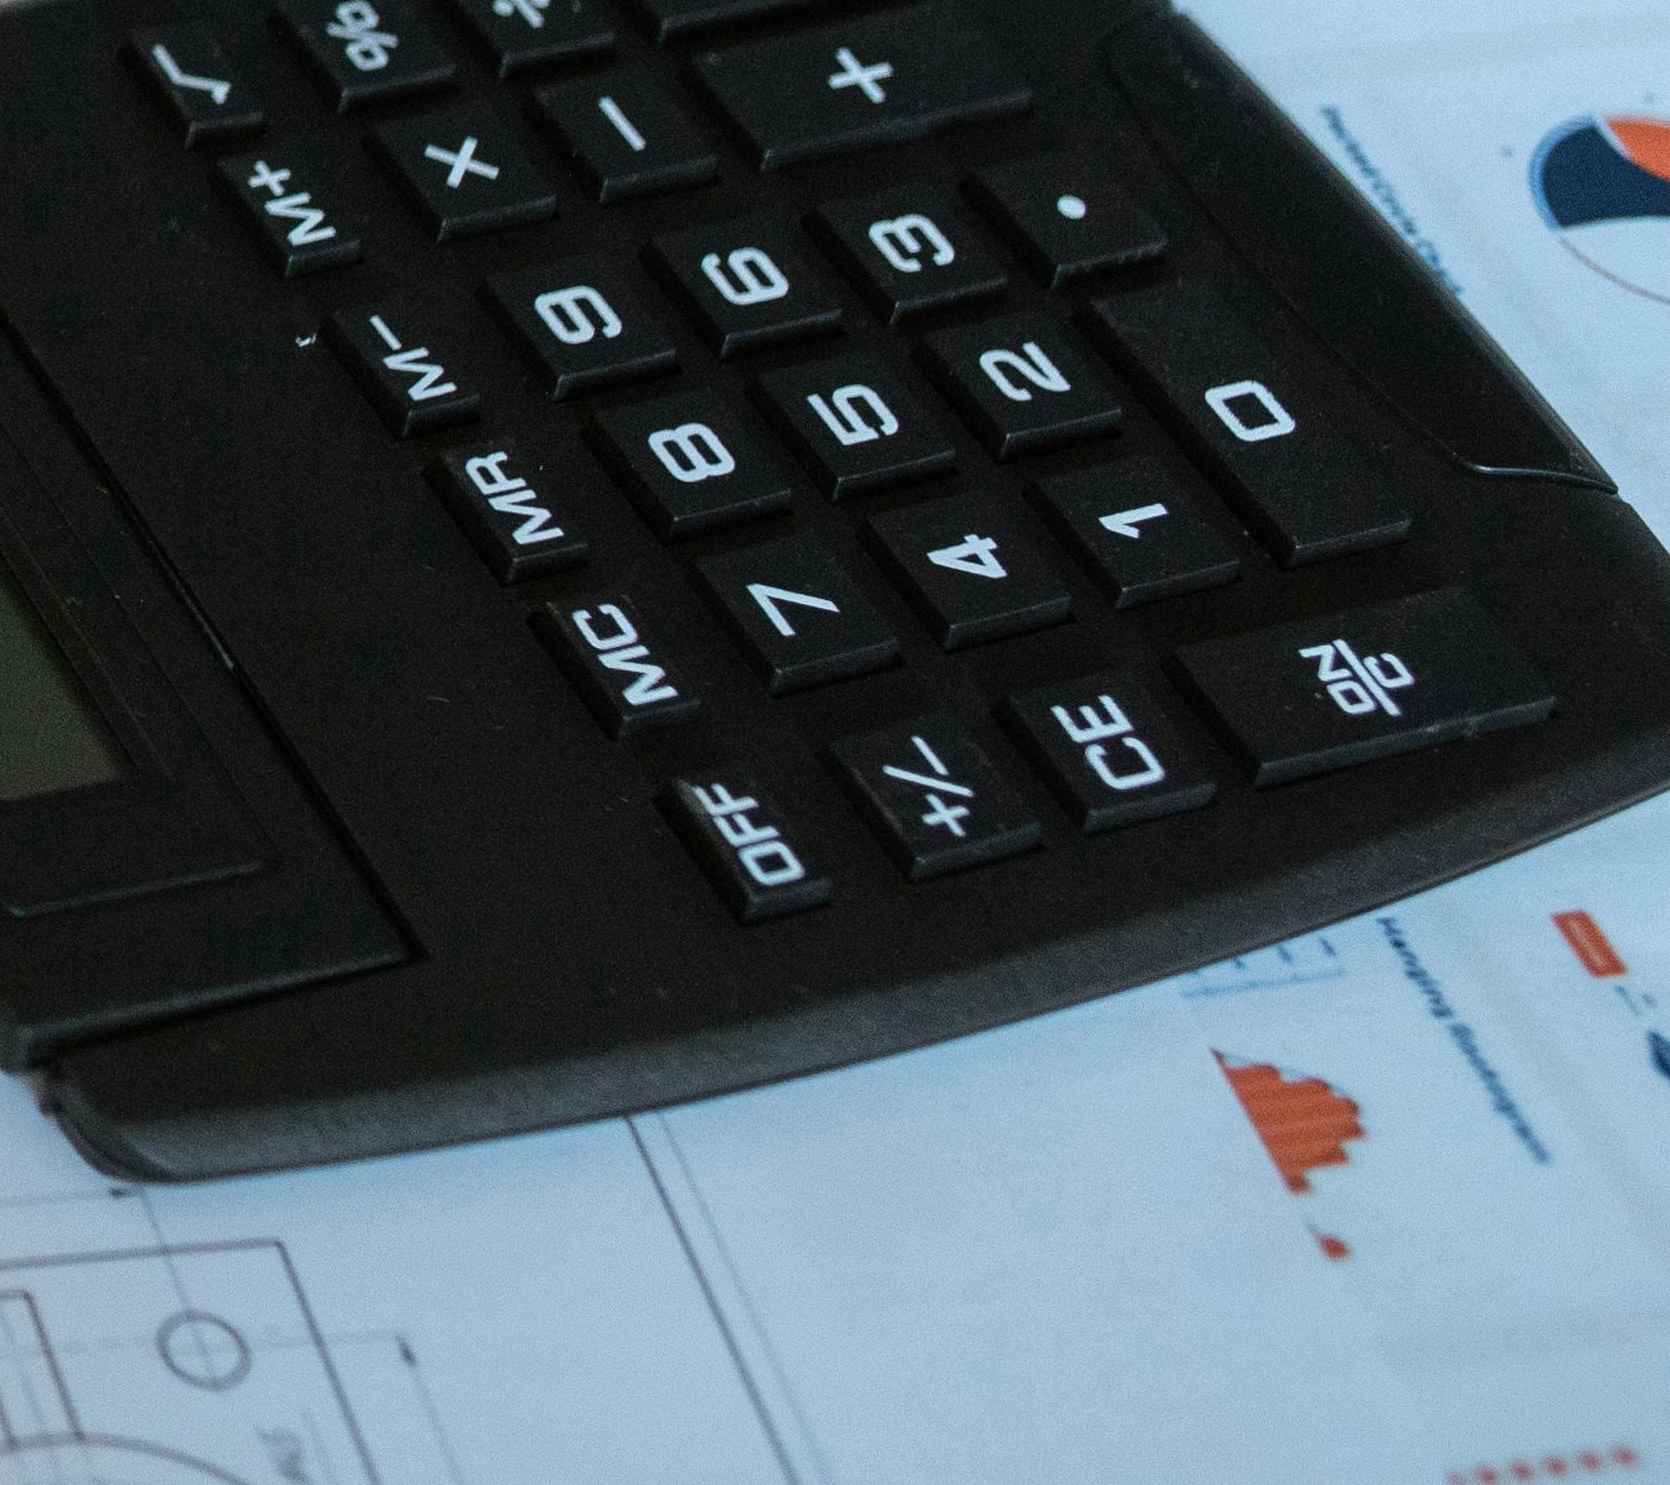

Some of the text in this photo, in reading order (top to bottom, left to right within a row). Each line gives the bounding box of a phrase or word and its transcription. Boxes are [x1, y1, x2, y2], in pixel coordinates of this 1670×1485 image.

[326, 0, 398, 72] %
[247, 160, 337, 247] M+
[867, 213, 956, 274] 3
[700, 246, 791, 307] 9
[533, 284, 624, 346] 6
[978, 340, 1072, 403] 2
[806, 383, 901, 447] 5
[1203, 378, 1298, 444] 0
[646, 421, 737, 484] 8
[464, 450, 565, 546] MR
[1097, 501, 1169, 540] 1
[926, 532, 1008, 580] 4
[746, 582, 840, 638] 7
[571, 602, 679, 707] MC
[1050, 693, 1166, 792] CE
[691, 782, 806, 887] OFF
